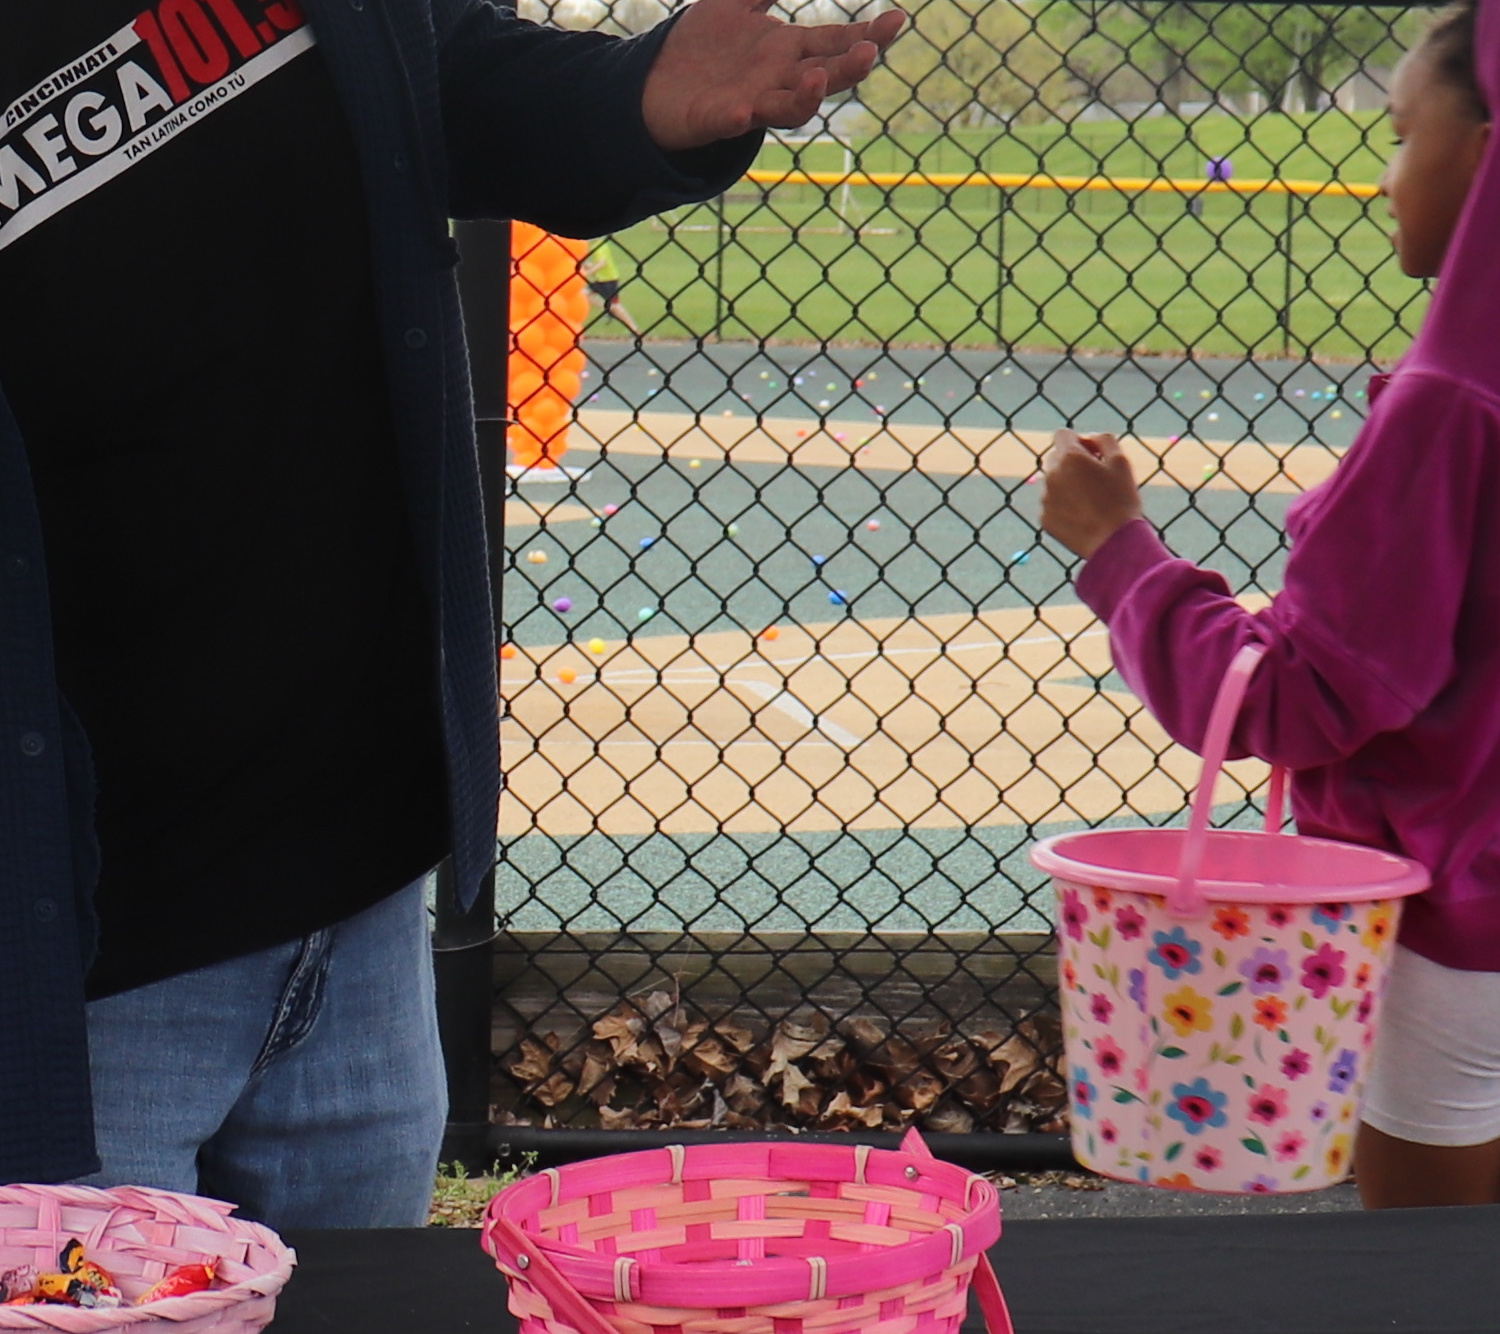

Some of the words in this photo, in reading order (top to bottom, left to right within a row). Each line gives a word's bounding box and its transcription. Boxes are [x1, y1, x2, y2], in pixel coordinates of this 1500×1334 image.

[6, 43, 118, 127] CINCINNATI
[123, 136, 151, 161] TAN
[151, 112, 189, 142] LATINA
[188, 86, 228, 118] COMO
[227, 72, 247, 91] TÚ
